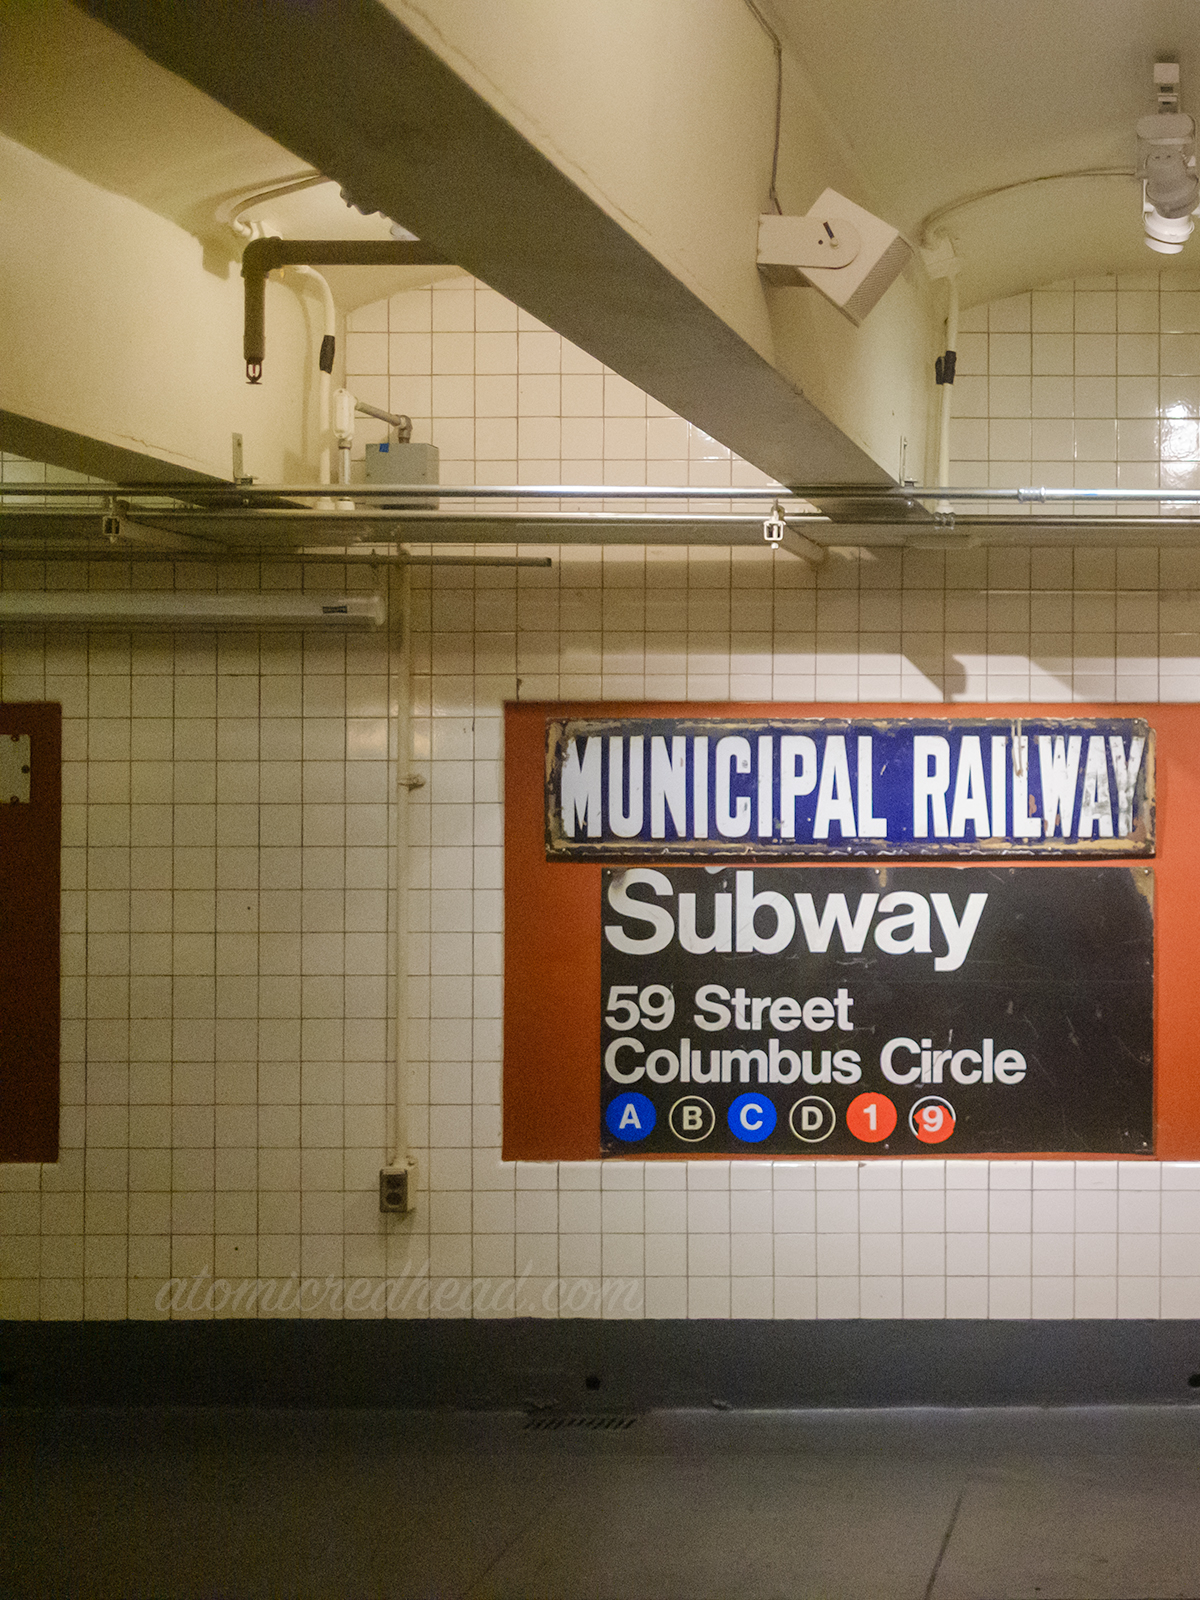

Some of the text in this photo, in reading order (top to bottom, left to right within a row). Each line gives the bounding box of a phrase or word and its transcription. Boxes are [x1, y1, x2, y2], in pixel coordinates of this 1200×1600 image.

[560, 735, 1145, 839] MUNICIPAL RAILWAY
[604, 869, 988, 972] Subway
[604, 985, 853, 1031] 59 Street
[604, 1037, 1027, 1085] Columbus Circle
[619, 1103, 943, 1133] A B C D 1 9
